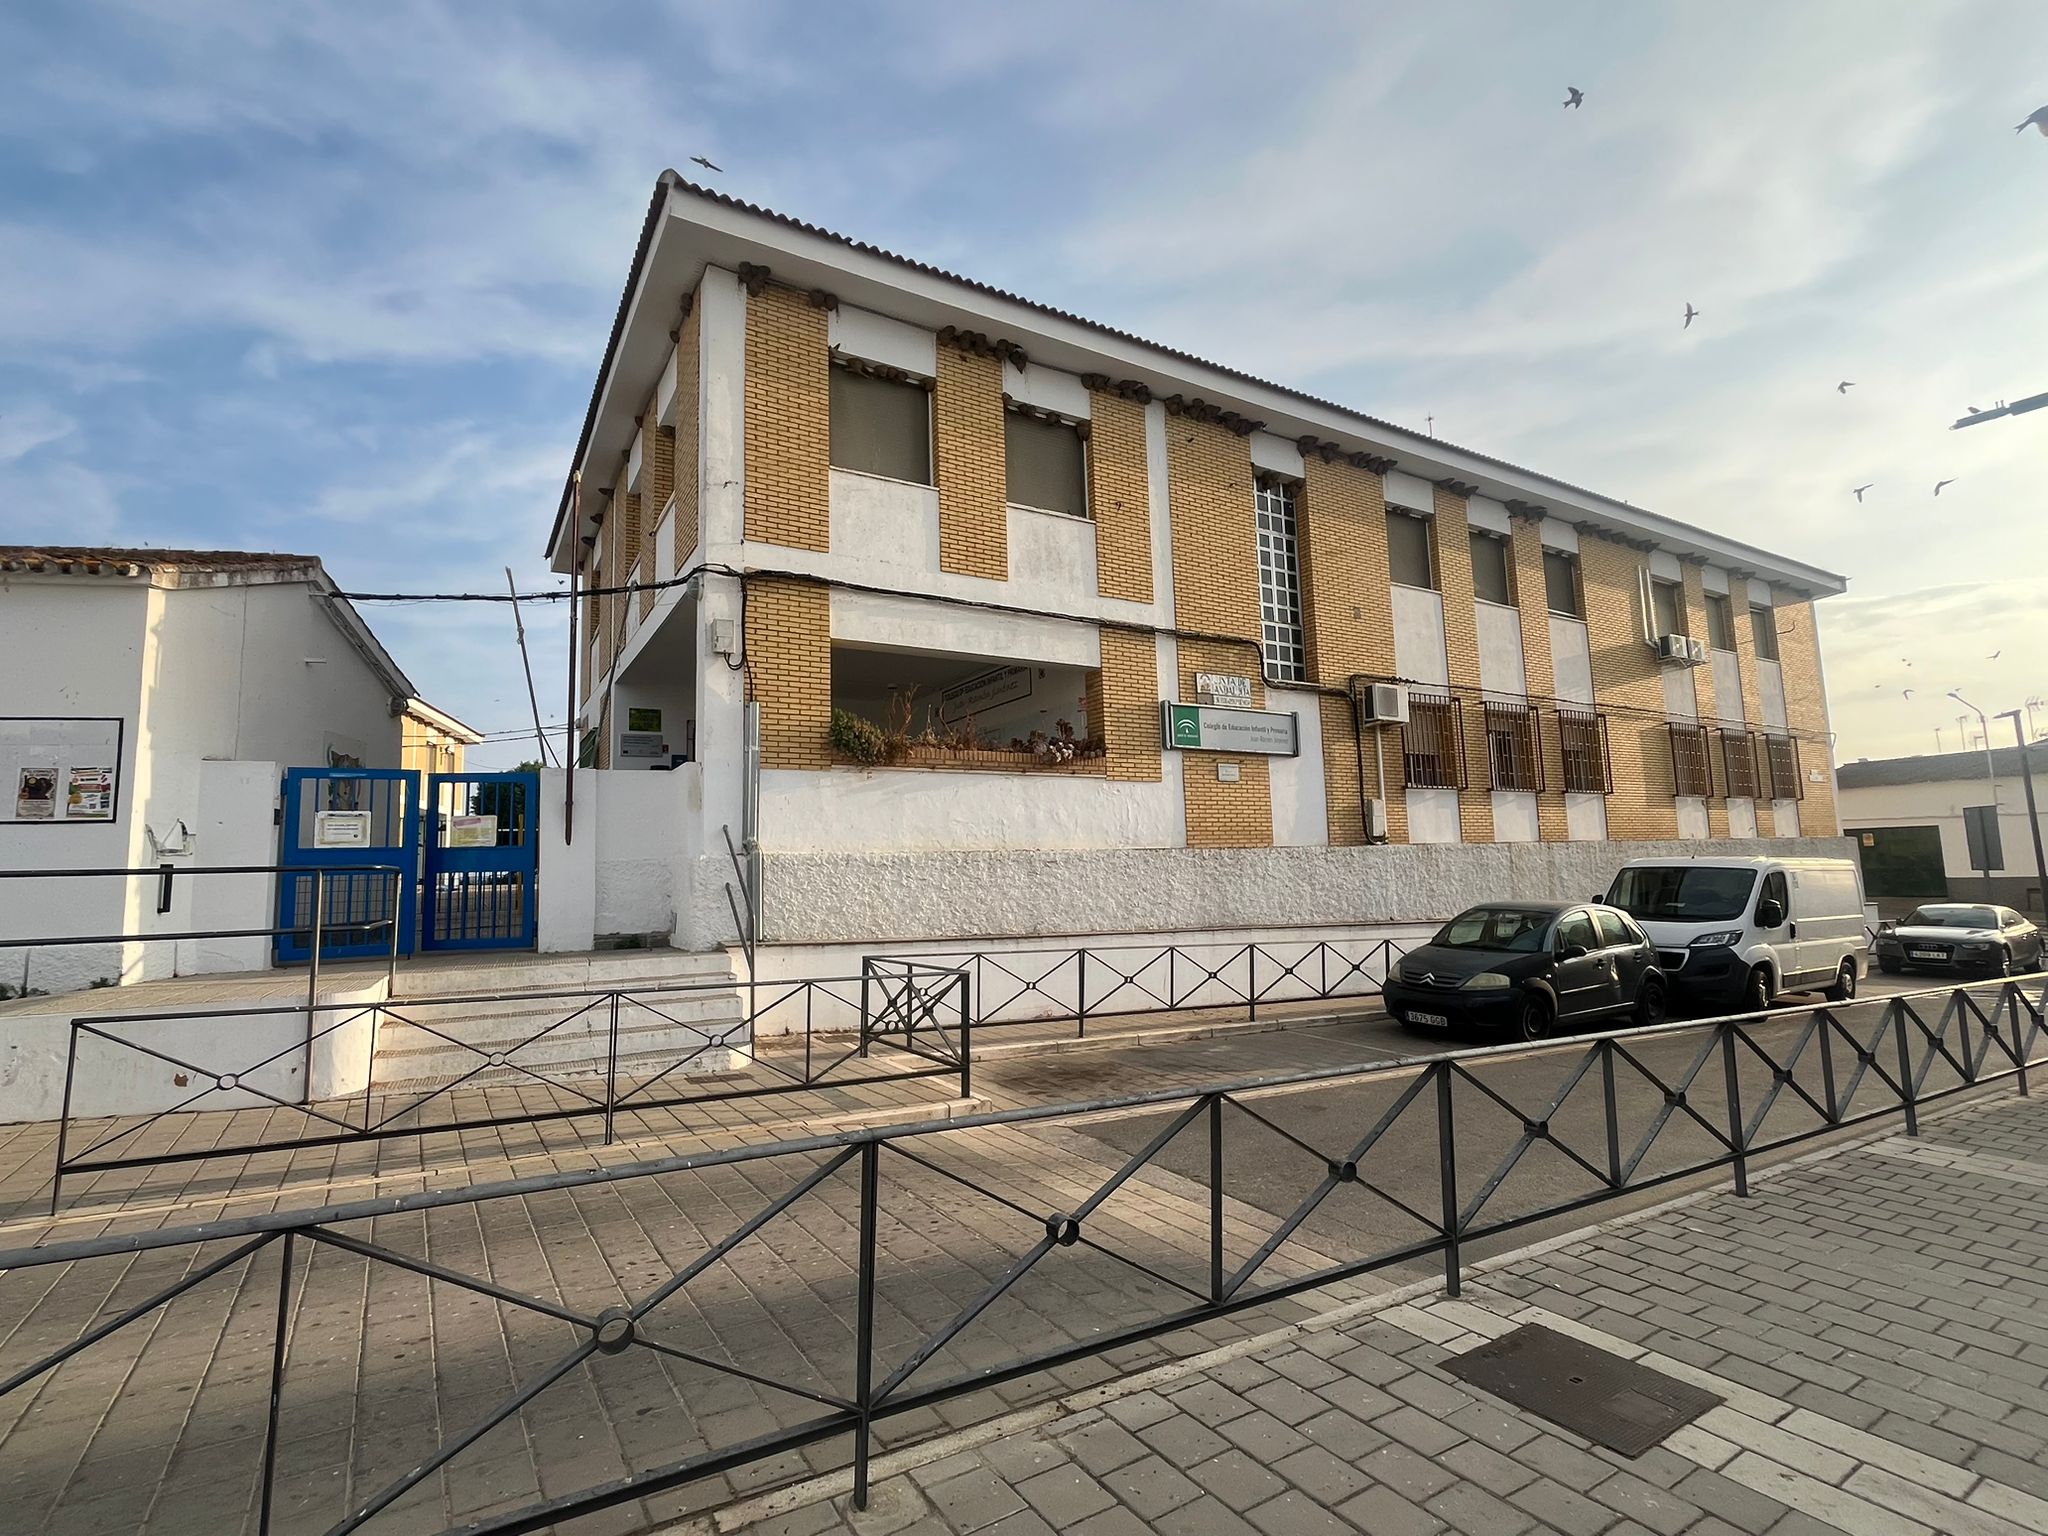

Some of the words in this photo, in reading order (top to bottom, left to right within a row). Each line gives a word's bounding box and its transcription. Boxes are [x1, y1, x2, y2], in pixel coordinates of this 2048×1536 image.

[1203, 722, 1221, 731] Colegio
[1251, 724, 1266, 733] Infantil
[1270, 726, 1288, 735] Primaria
